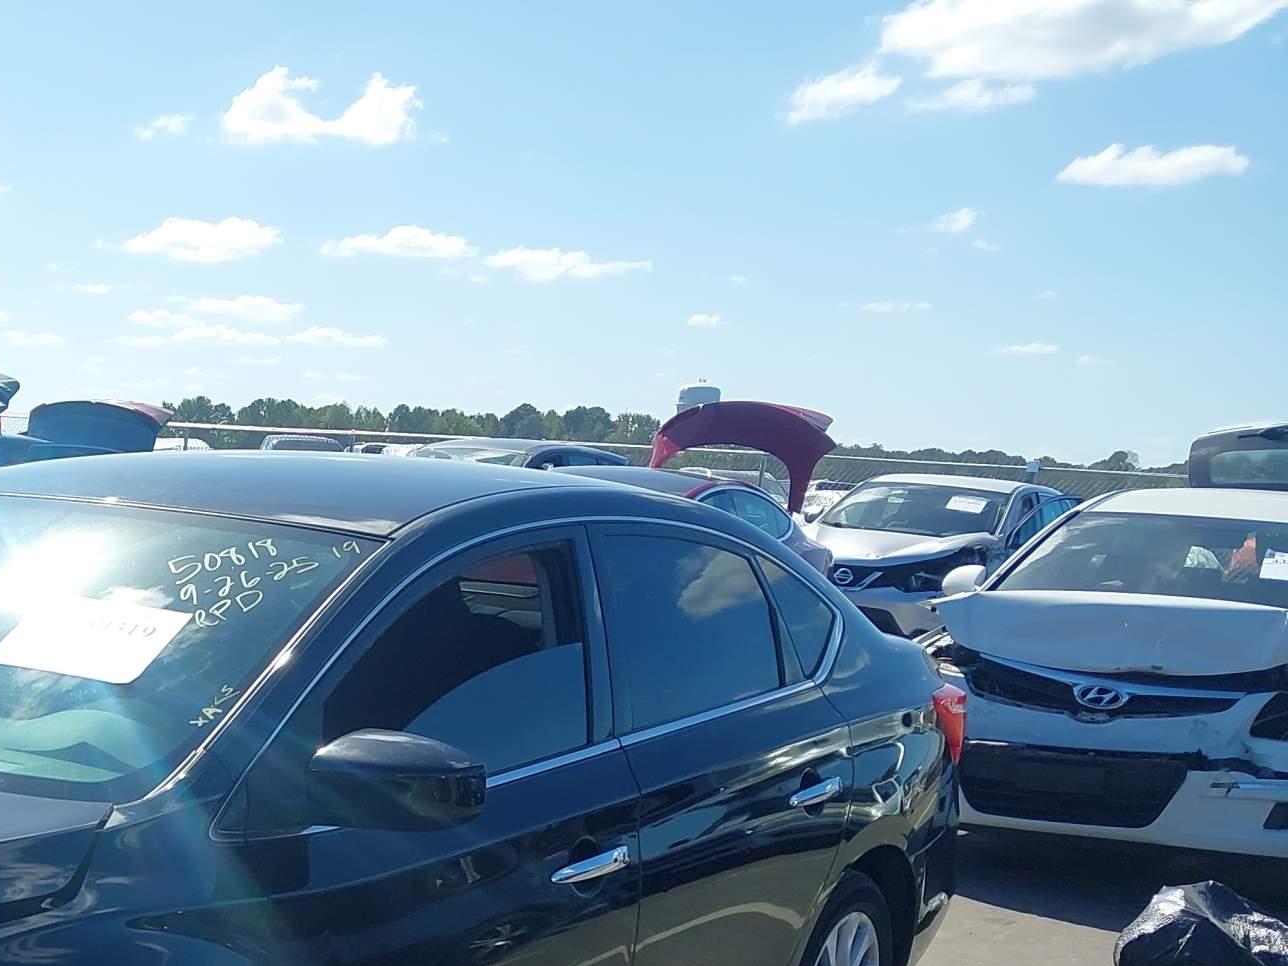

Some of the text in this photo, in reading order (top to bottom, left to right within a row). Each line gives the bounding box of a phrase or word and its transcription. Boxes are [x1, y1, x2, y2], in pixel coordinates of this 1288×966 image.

[168, 538, 278, 584] 50818
[332, 540, 361, 559] 19
[194, 590, 263, 628] RPD
